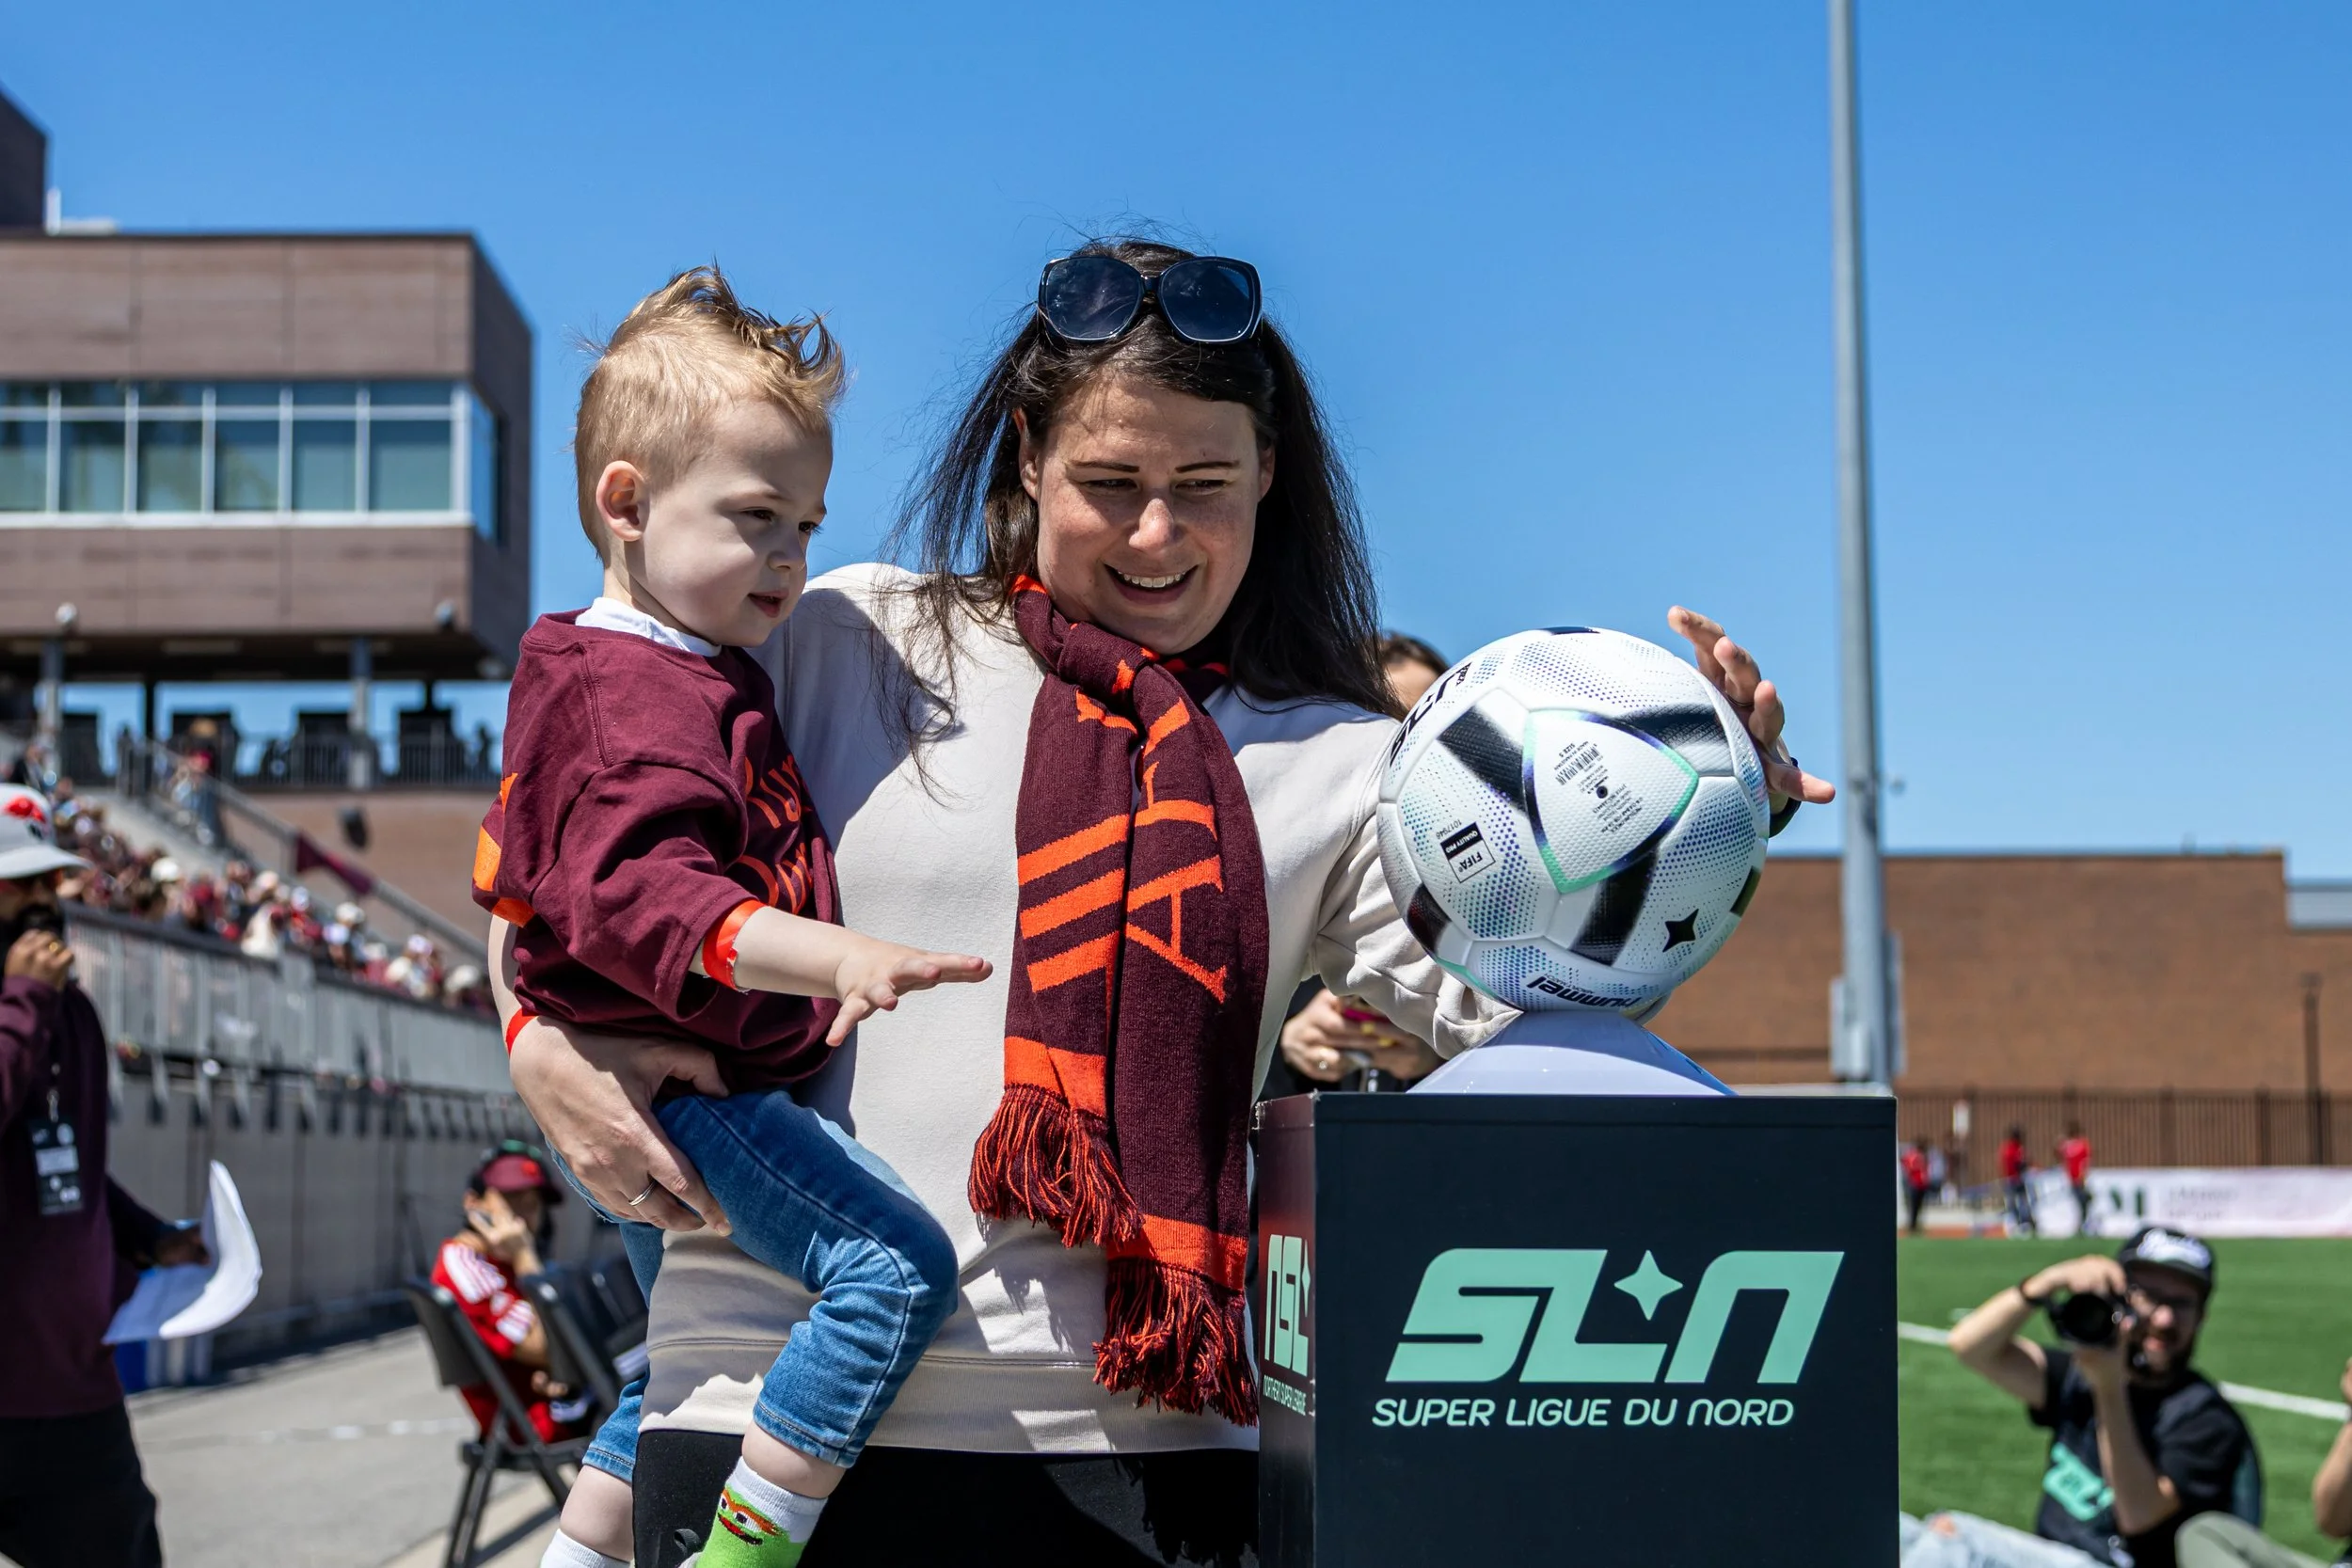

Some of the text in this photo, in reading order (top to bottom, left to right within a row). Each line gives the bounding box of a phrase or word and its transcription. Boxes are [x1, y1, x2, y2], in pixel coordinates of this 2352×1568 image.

[1457, 831, 1478, 846] QUALITY
[1527, 976, 1641, 1007] hummel
[1373, 1398, 1795, 1427] SUPER LIGUE DU NORD
